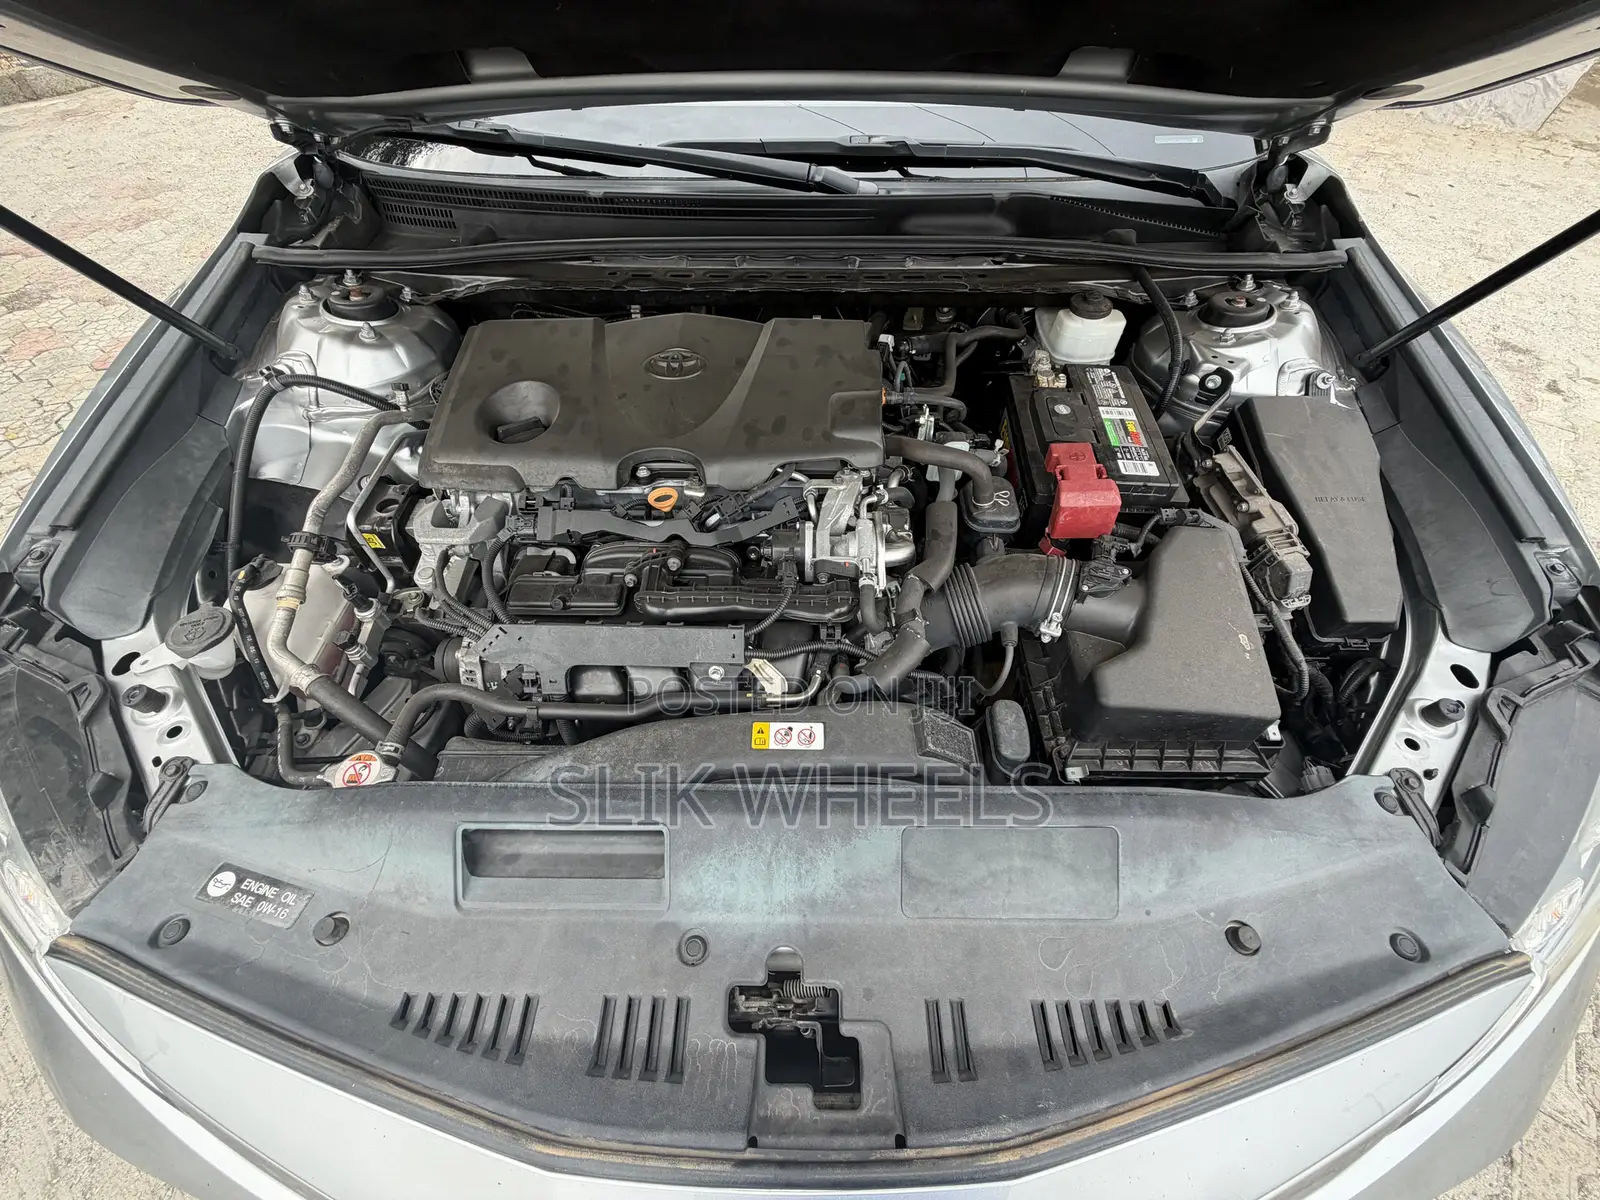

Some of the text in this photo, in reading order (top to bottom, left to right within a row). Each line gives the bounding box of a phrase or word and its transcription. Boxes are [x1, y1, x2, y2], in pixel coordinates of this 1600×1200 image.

[231, 892, 289, 920] SAE 0W-16
[240, 878, 297, 906] ENGINE OIL
